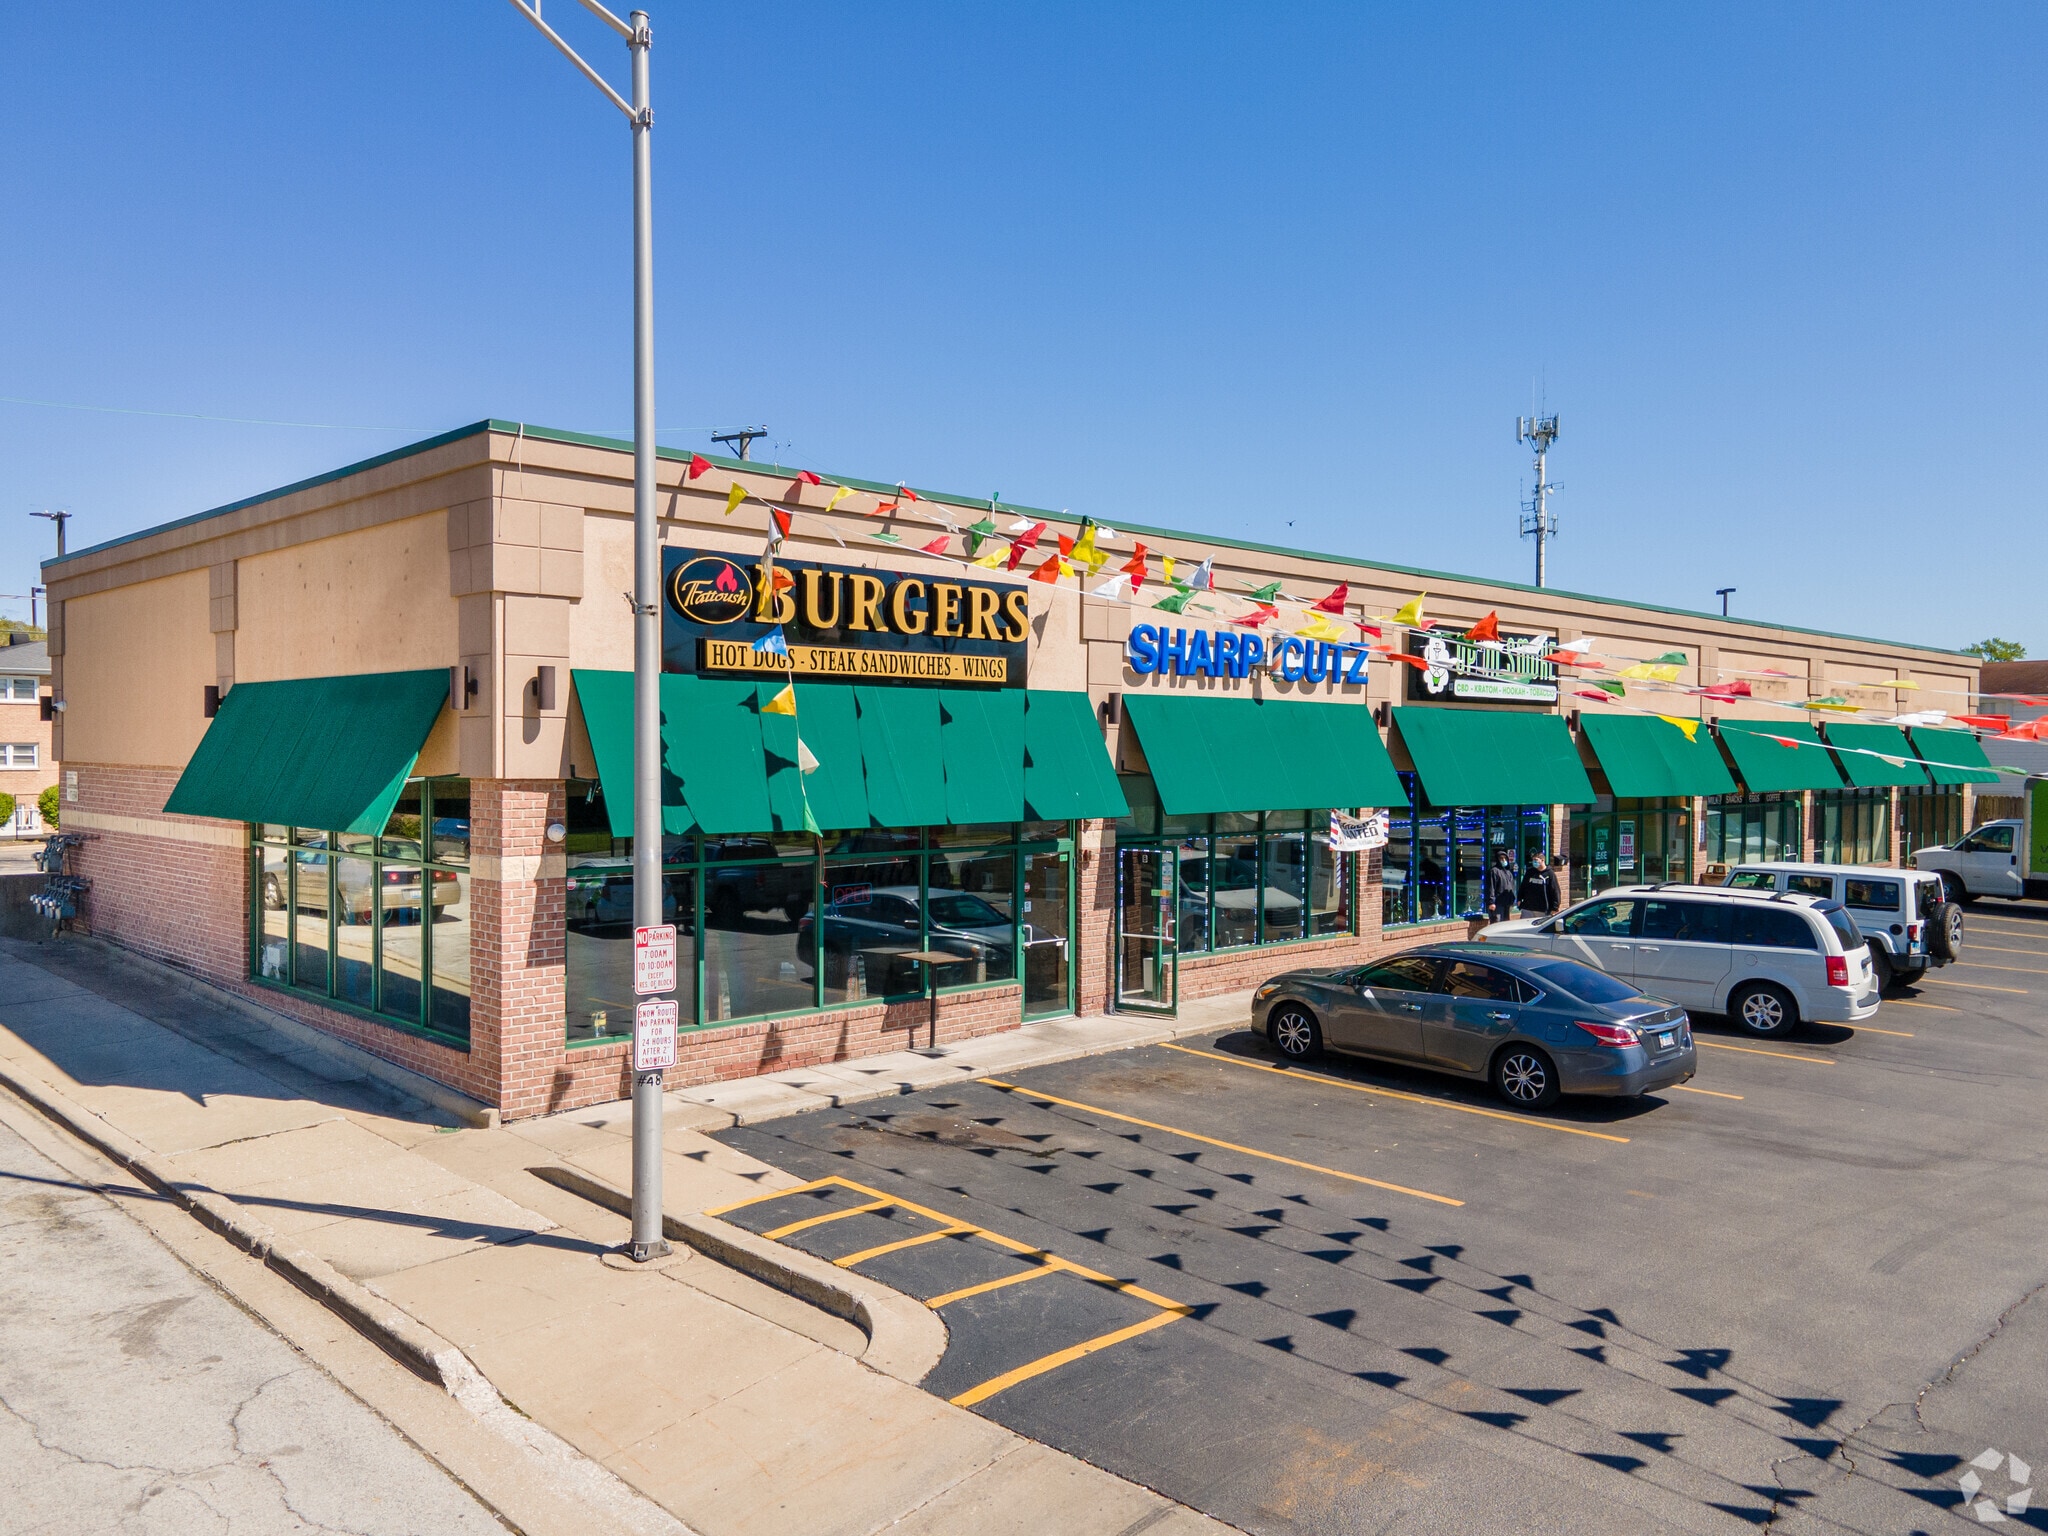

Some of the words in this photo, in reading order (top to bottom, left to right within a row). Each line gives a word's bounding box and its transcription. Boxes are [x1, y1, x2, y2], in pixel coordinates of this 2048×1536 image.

[755, 564, 1031, 642] BURGERS
[1130, 623, 1264, 678] SHARP
[1282, 637, 1371, 684] CUTZ
[712, 644, 747, 667] HOT
[753, 647, 795, 669] DOGS
[810, 649, 857, 671] STEAK
[861, 651, 951, 676] SANDWICHES
[963, 657, 1004, 678] WINGS
[1456, 683, 1469, 692] CBD
[1474, 685, 1498, 694] KRATOM
[1503, 686, 1526, 696] HOOKAH
[1622, 835, 1631, 844] FOR
[1620, 845, 1633, 855] LEASE
[834, 886, 870, 904] OPEN
[637, 931, 648, 944] NO
[649, 932, 673, 941] PARKING
[639, 962, 645, 971] TO
[648, 960, 673, 970] 10:00AM
[648, 971, 664, 979] EXCEPT
[658, 979, 672, 987] BLOCK
[639, 1010, 655, 1018] SNOW
[657, 1007, 676, 1016] ROUTE
[640, 1019, 647, 1028] NO
[650, 1018, 675, 1027] PARKING
[651, 1028, 663, 1036] FOR
[642, 1038, 649, 1047] 24
[651, 1037, 672, 1046] HOURS
[642, 1047, 661, 1056] AFTER
[641, 1056, 671, 1066] SNOWFALL
[637, 1074, 662, 1087] #48
